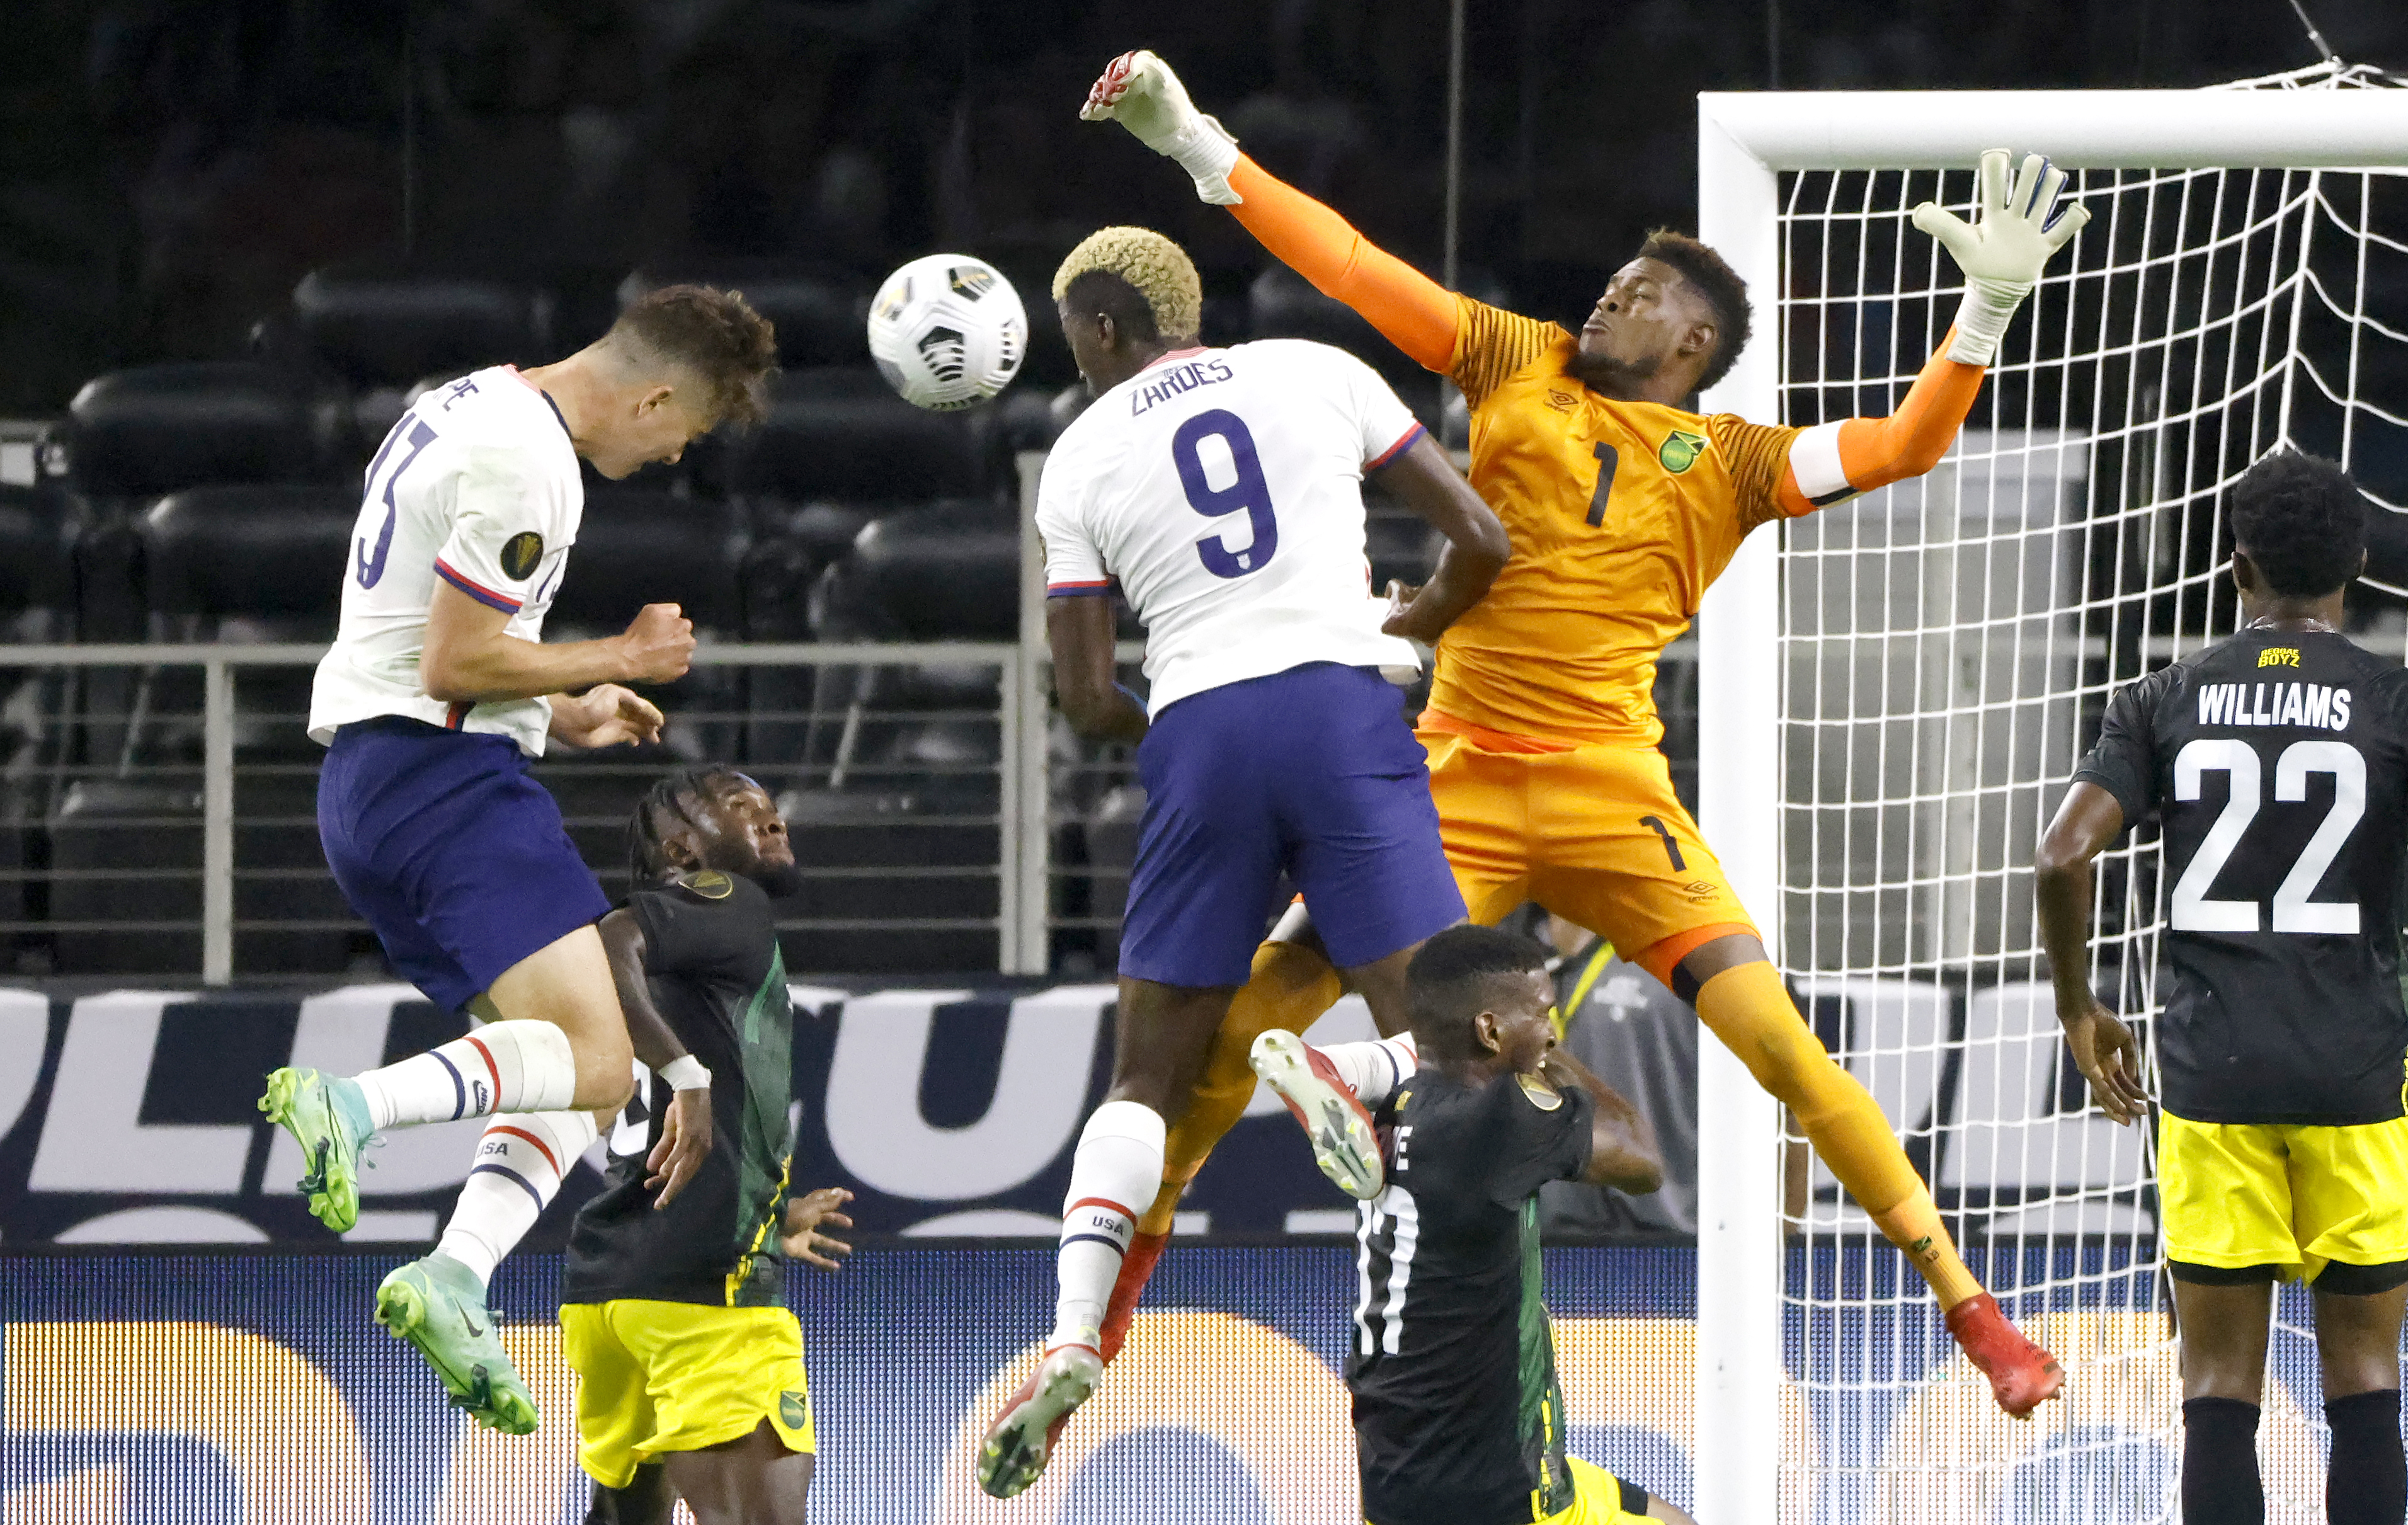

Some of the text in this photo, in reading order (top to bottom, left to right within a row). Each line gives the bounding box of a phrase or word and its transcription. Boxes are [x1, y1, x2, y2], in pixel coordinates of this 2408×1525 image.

[1124, 358, 1233, 418] ZARDES
[1172, 408, 1278, 579] 9
[1585, 440, 1619, 528] 1
[2257, 653, 2301, 668] BOYZ
[2198, 682, 2352, 731] WILLIAMS
[1638, 815, 1688, 873] 1
[2171, 738, 2368, 935] 22
[1092, 1215, 1124, 1237] USA
